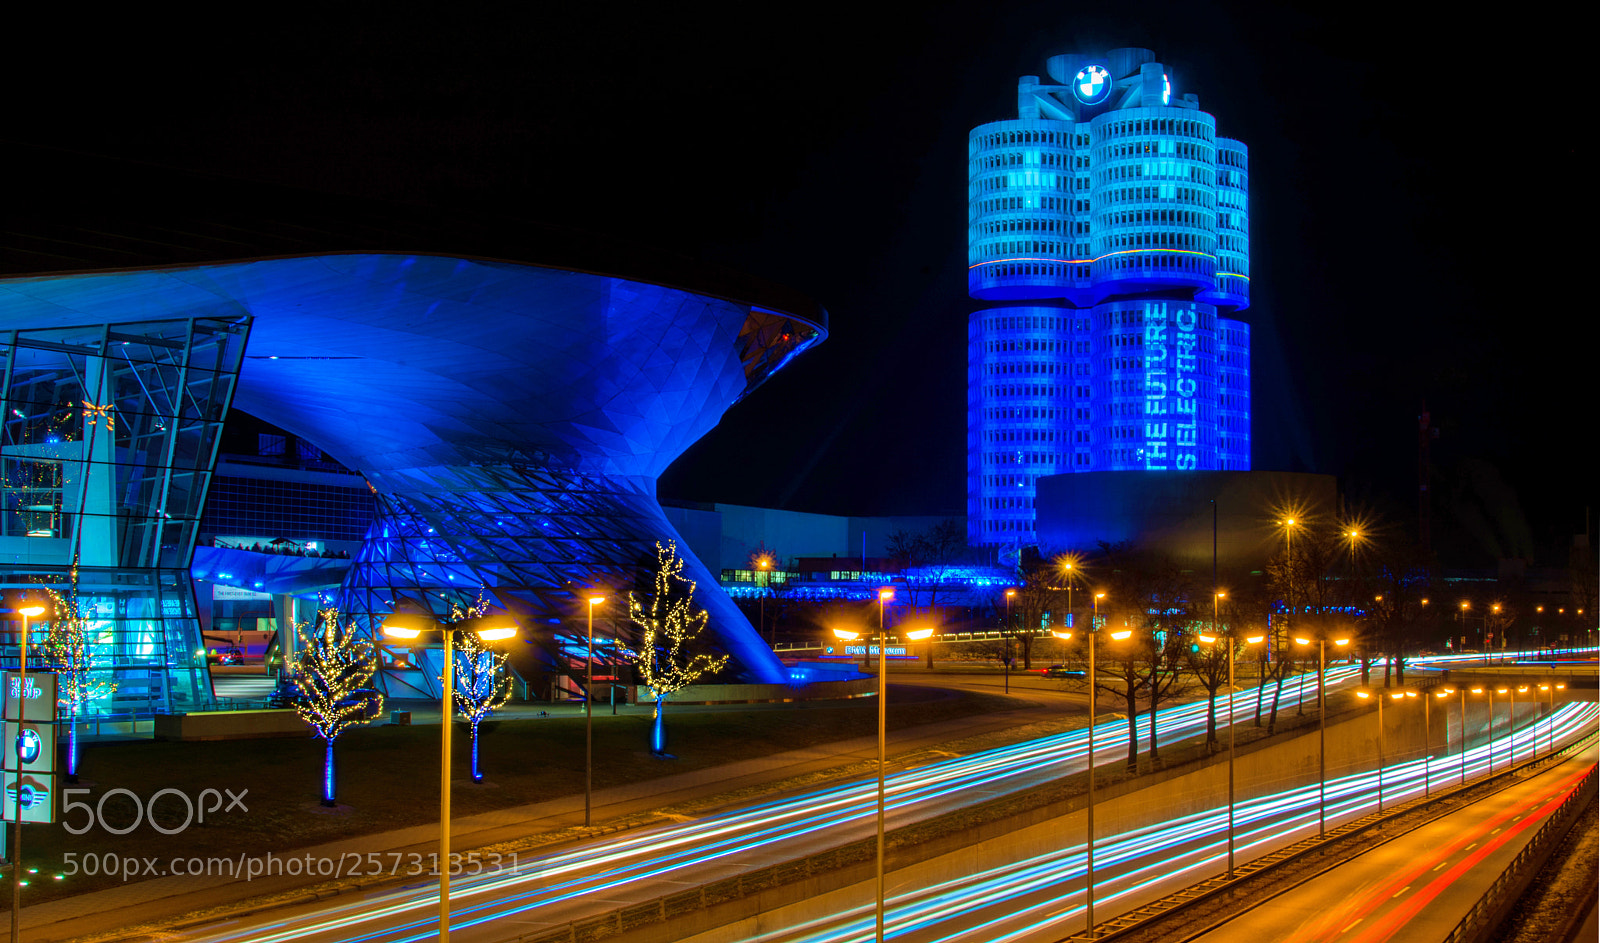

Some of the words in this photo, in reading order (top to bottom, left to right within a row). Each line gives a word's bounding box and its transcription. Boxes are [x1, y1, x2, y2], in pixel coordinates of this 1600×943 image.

[1145, 302, 1167, 414] FUTURE
[1176, 303, 1196, 446] ELECTRIC.
[1145, 422, 1167, 470] THE
[1176, 453, 1196, 470] S
